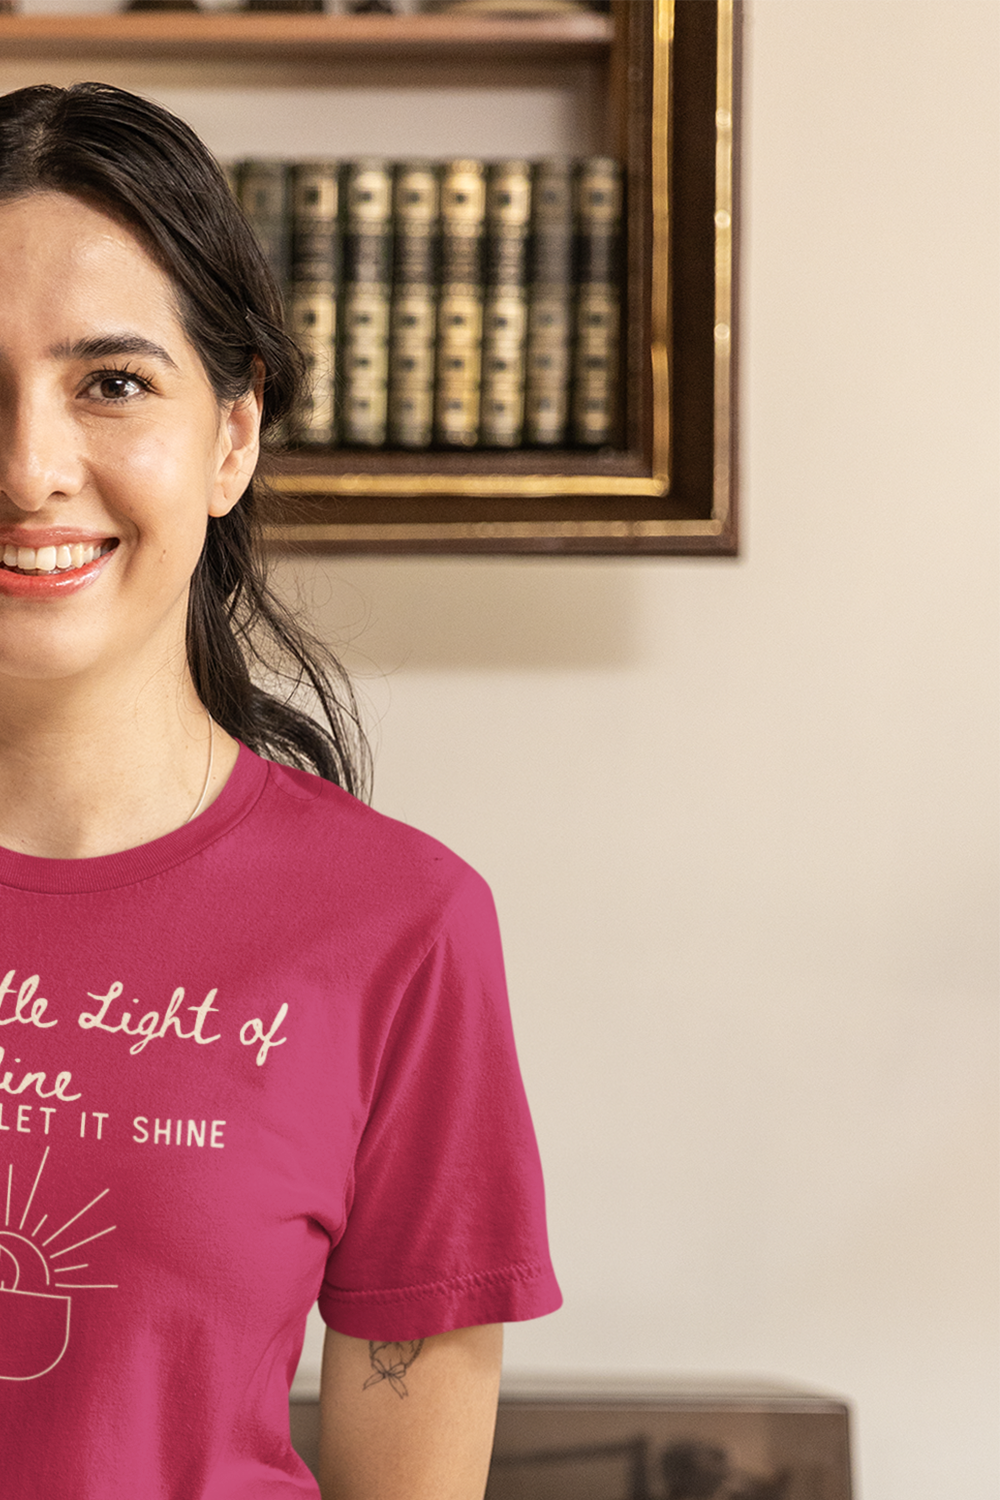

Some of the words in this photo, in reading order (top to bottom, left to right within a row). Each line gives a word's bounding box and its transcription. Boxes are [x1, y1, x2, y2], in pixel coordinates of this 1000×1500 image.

[77, 980, 222, 1056] Light
[239, 1002, 289, 1067] of
[79, 1111, 110, 1141] IT
[131, 1115, 228, 1149] SHINE
